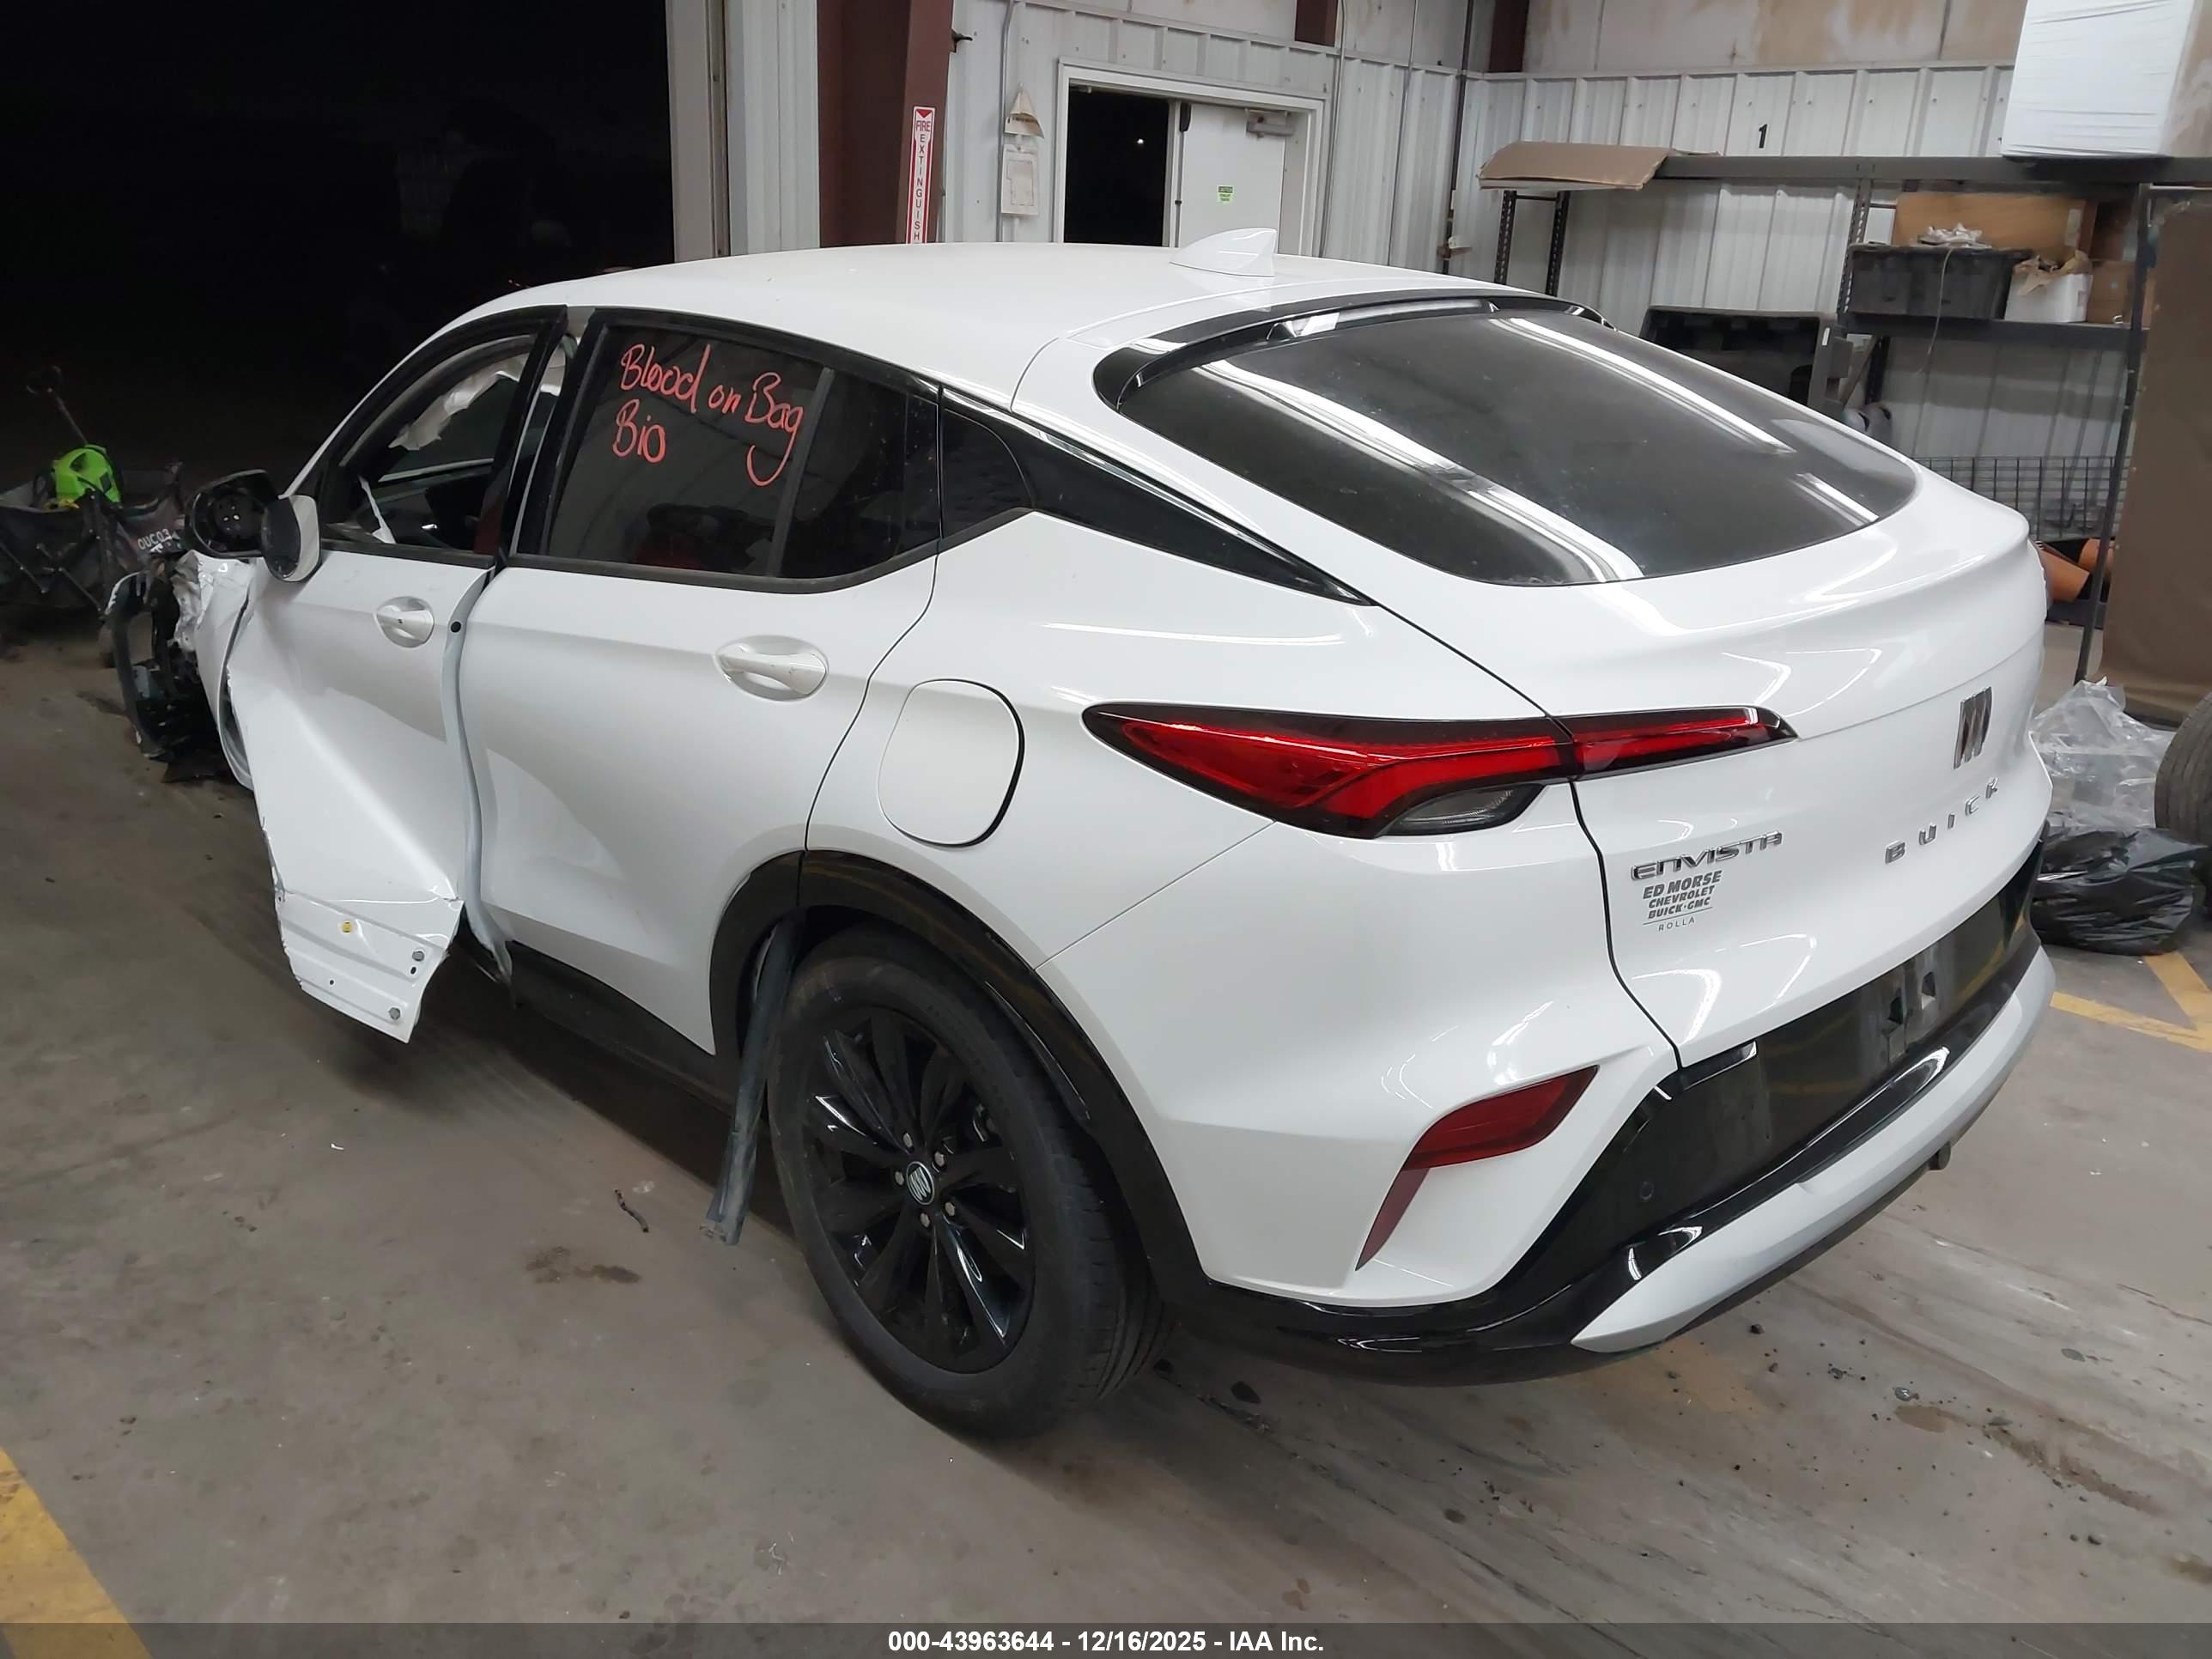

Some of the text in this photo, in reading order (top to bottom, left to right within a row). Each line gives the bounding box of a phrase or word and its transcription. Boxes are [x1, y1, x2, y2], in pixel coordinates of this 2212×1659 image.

[915, 120, 931, 131] FIRE
[1759, 124, 1768, 149] 1
[914, 134, 926, 244] EXTINGUISH
[612, 398, 666, 463] Bio
[620, 343, 804, 486] Blood on Bag
[1885, 776, 1999, 865] BUICK
[1631, 830, 1784, 880] ENVISTA
[1643, 870, 1723, 900] ED MORSE
[1648, 884, 1716, 909] CHEVROLET
[1658, 915, 1695, 933] ROLLA
